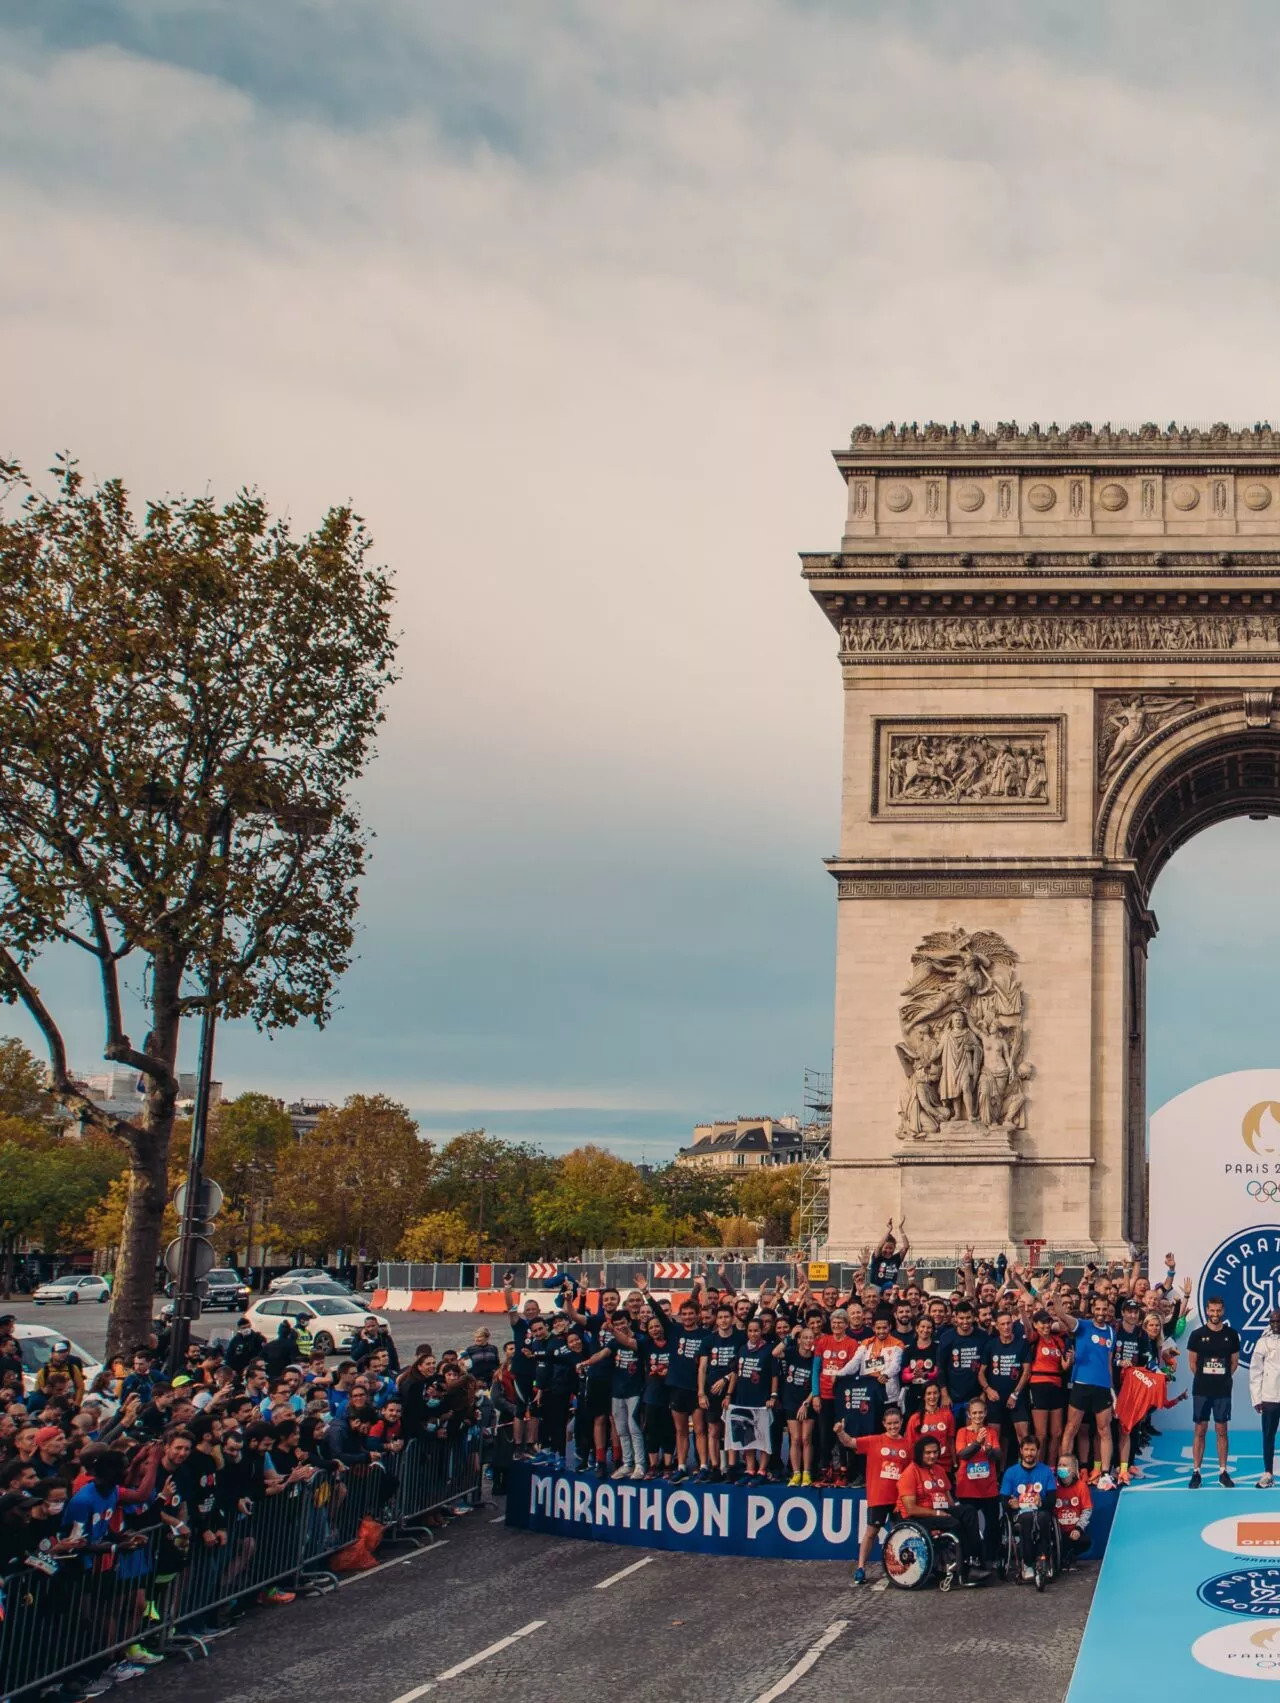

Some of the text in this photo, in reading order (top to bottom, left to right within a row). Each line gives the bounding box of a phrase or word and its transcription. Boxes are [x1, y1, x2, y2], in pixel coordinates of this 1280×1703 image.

[1225, 1164, 1269, 1174] PARIS
[530, 1474, 729, 1537] MARATHON
[1220, 1598, 1280, 1615] POUR
